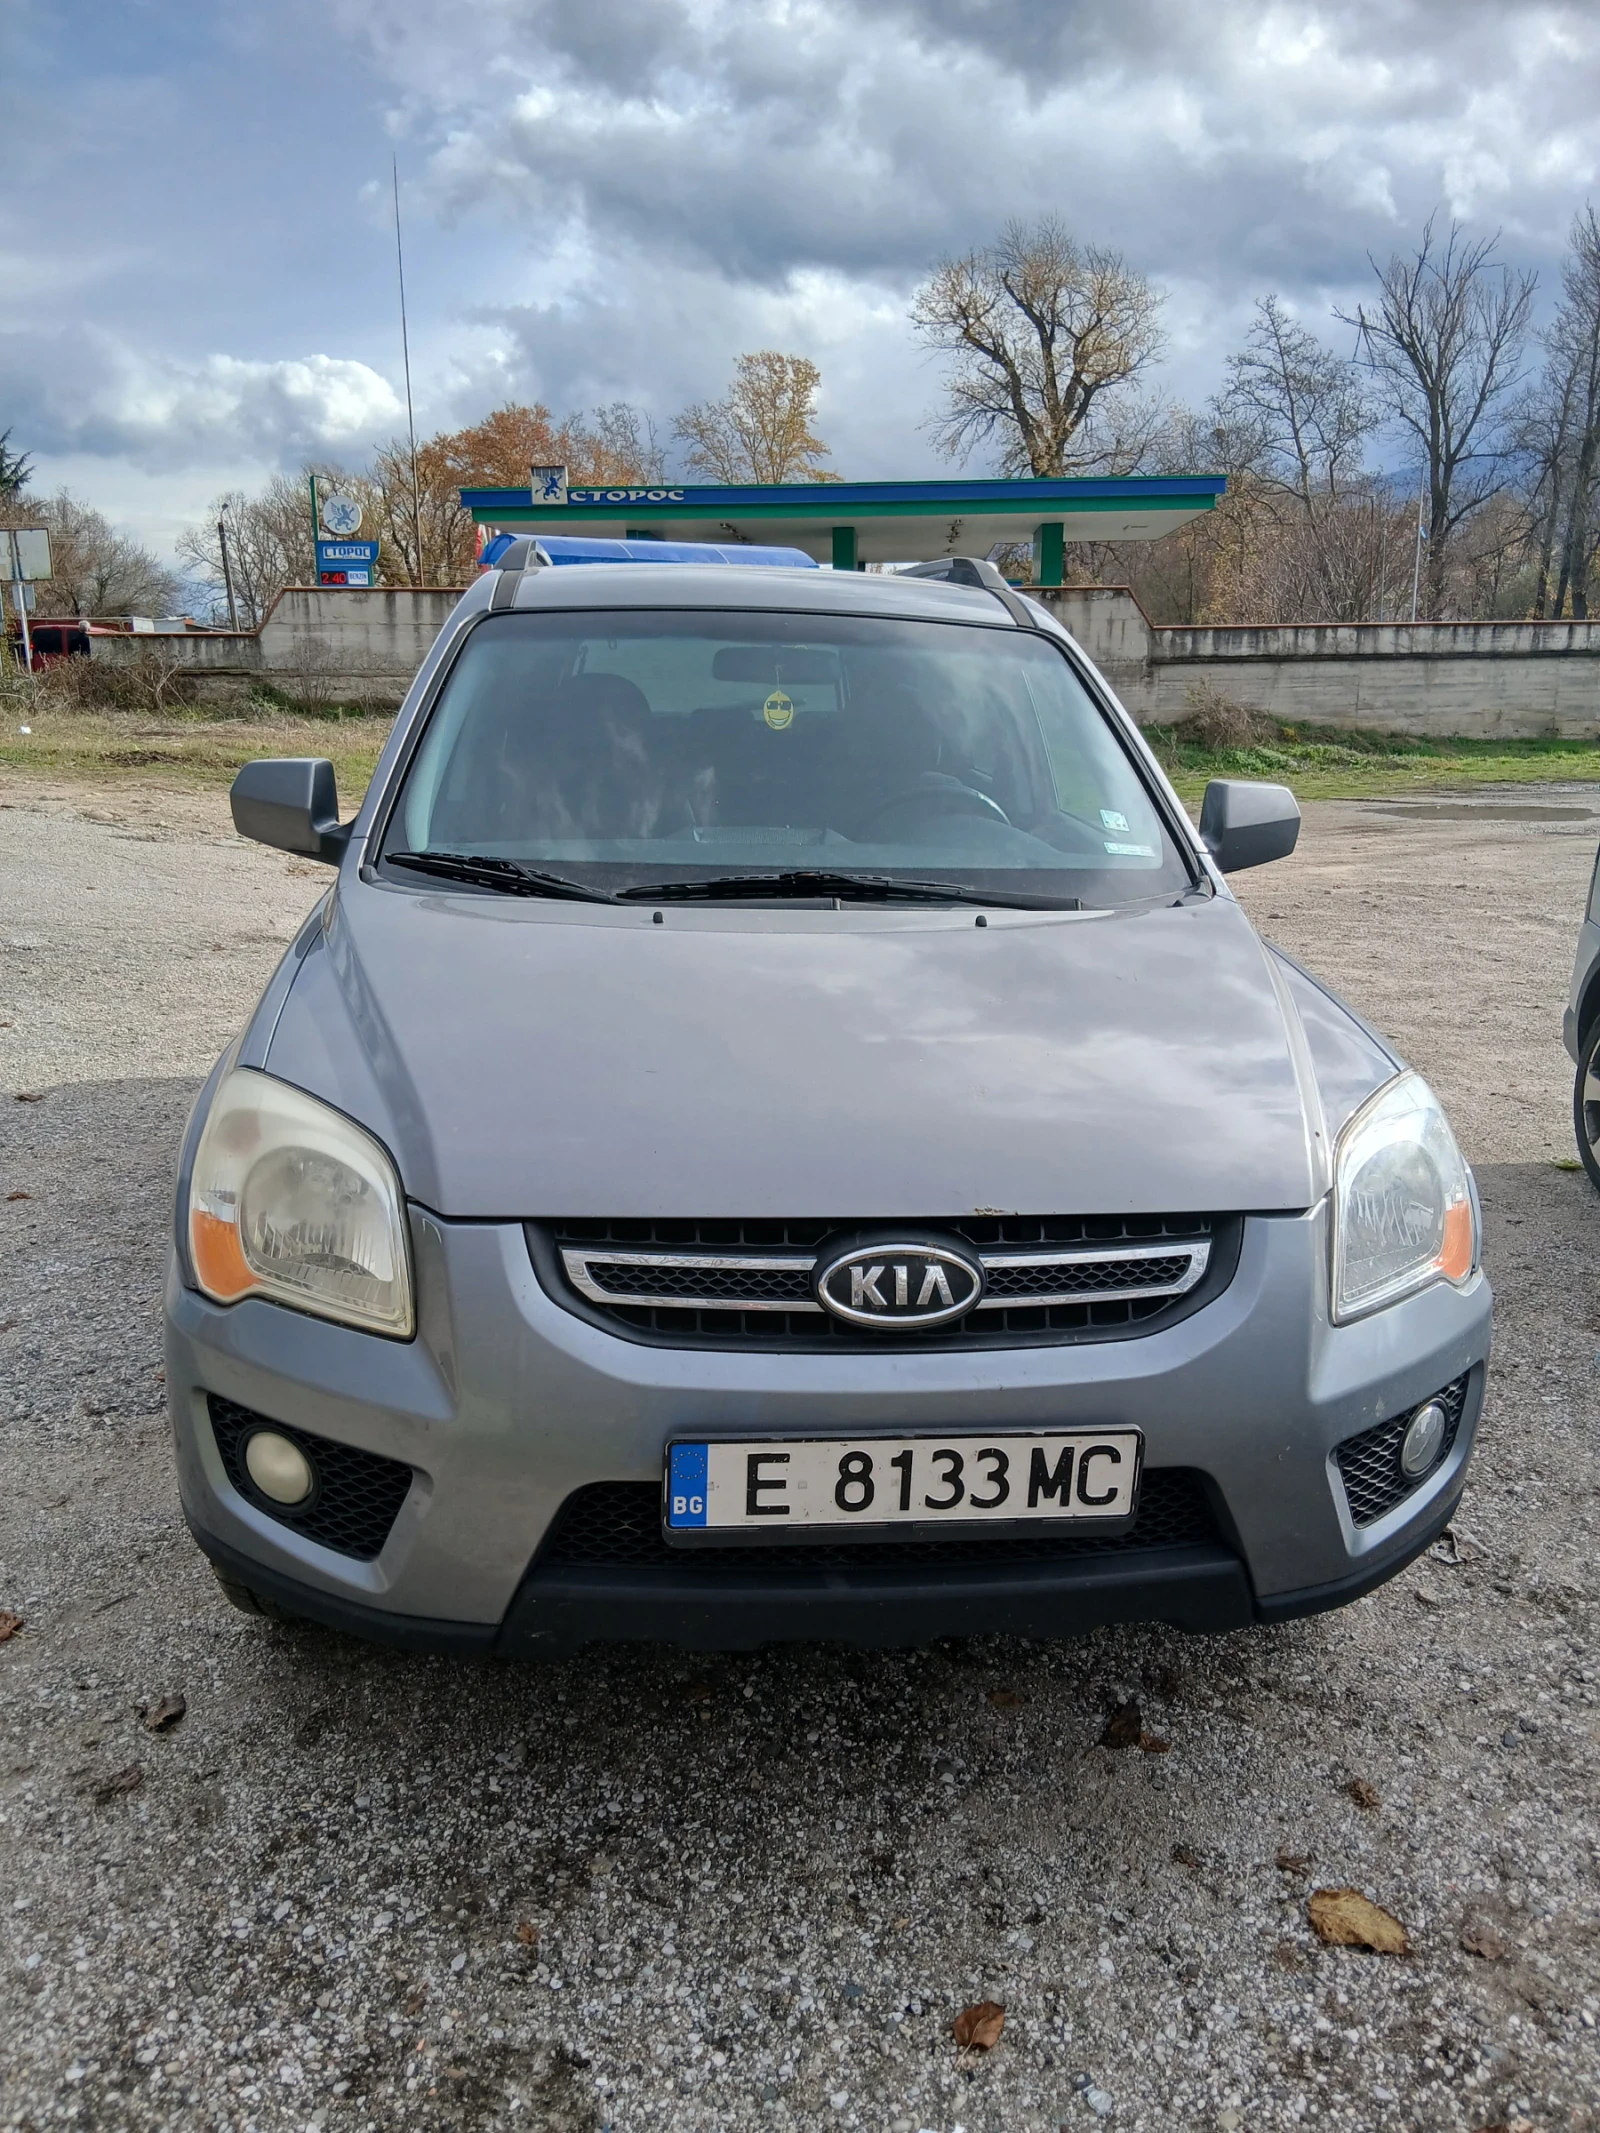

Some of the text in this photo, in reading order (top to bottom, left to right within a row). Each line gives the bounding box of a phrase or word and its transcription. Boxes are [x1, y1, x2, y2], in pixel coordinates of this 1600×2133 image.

[570, 490, 685, 502] СТОРОС
[324, 547, 370, 558] СТОРОС
[321, 572, 347, 584] 2.40
[849, 1265, 955, 1306] KIA
[746, 1445, 1122, 1516] E 8133 MC
[673, 1496, 703, 1515] BG
